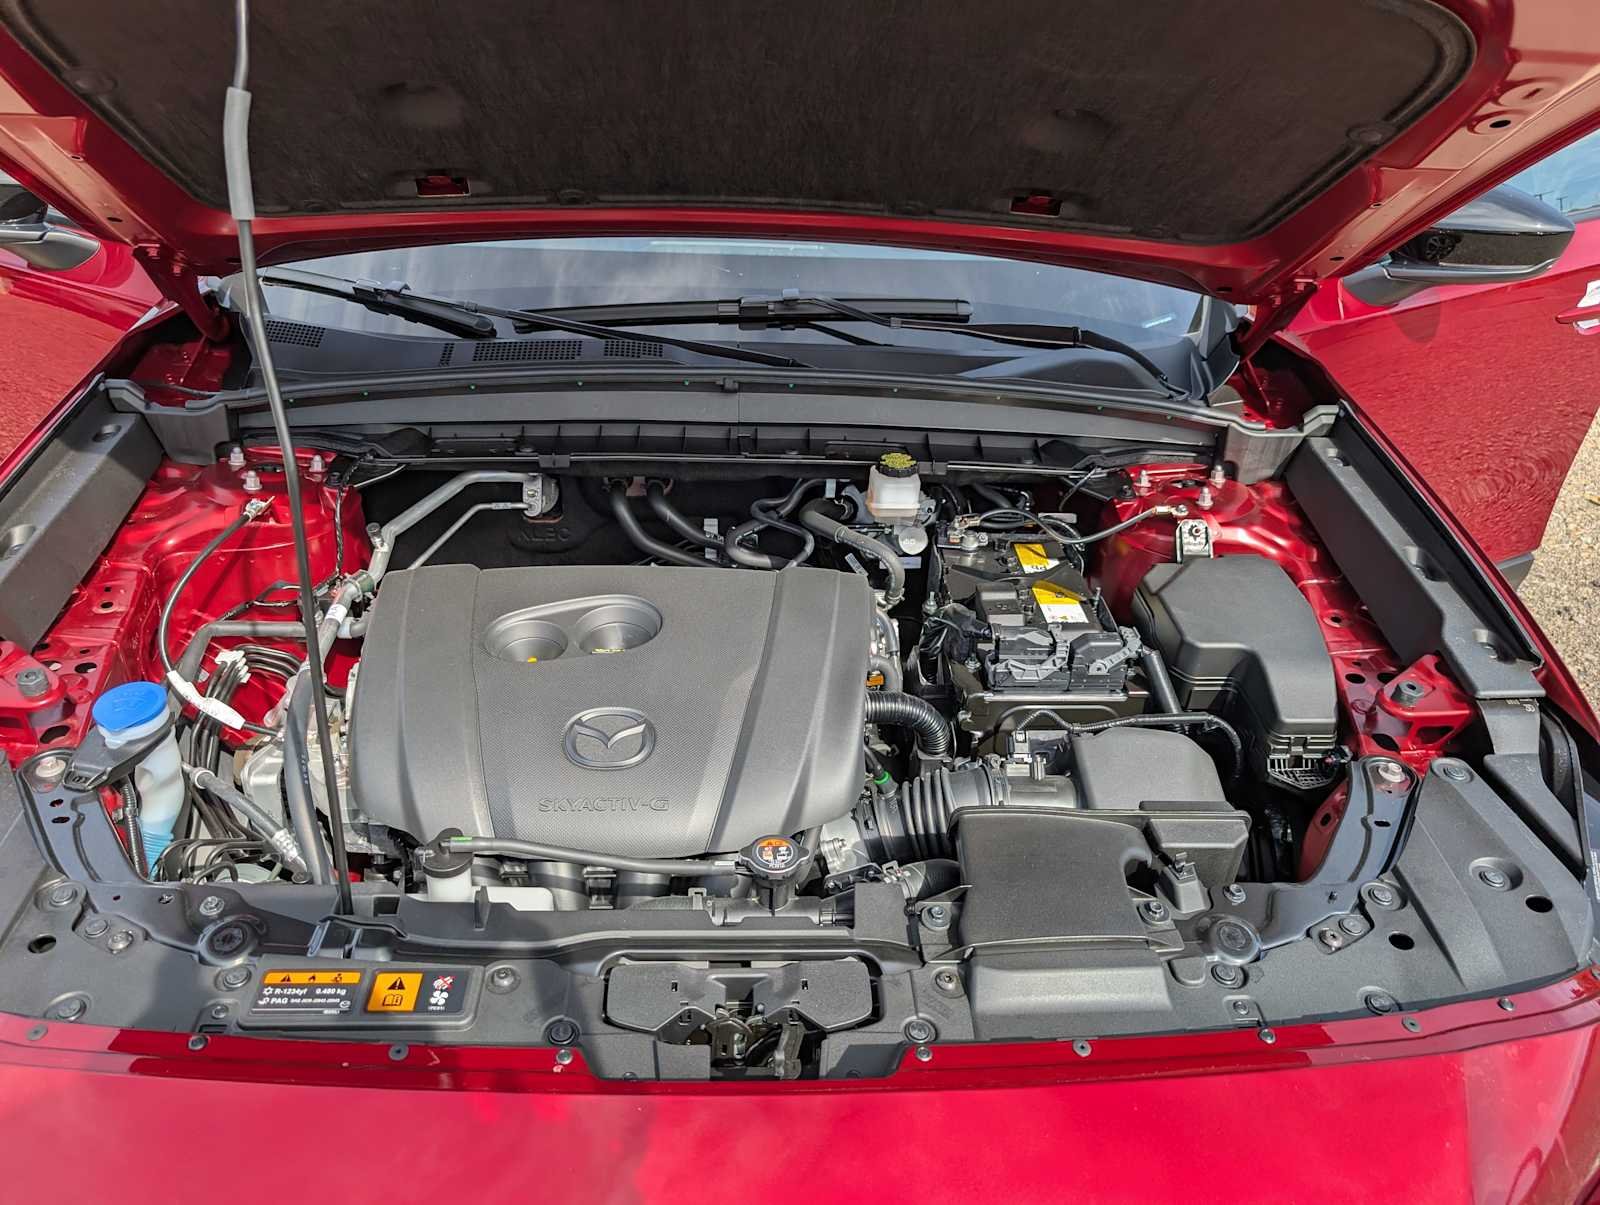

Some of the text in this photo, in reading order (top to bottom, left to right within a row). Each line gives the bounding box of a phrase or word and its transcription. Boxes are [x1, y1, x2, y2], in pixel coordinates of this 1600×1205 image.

[538, 797, 670, 813] SKYACTIV-G
[274, 987, 308, 996] R-1234yf
[336, 987, 347, 996] kg
[270, 997, 289, 1005] PAG
